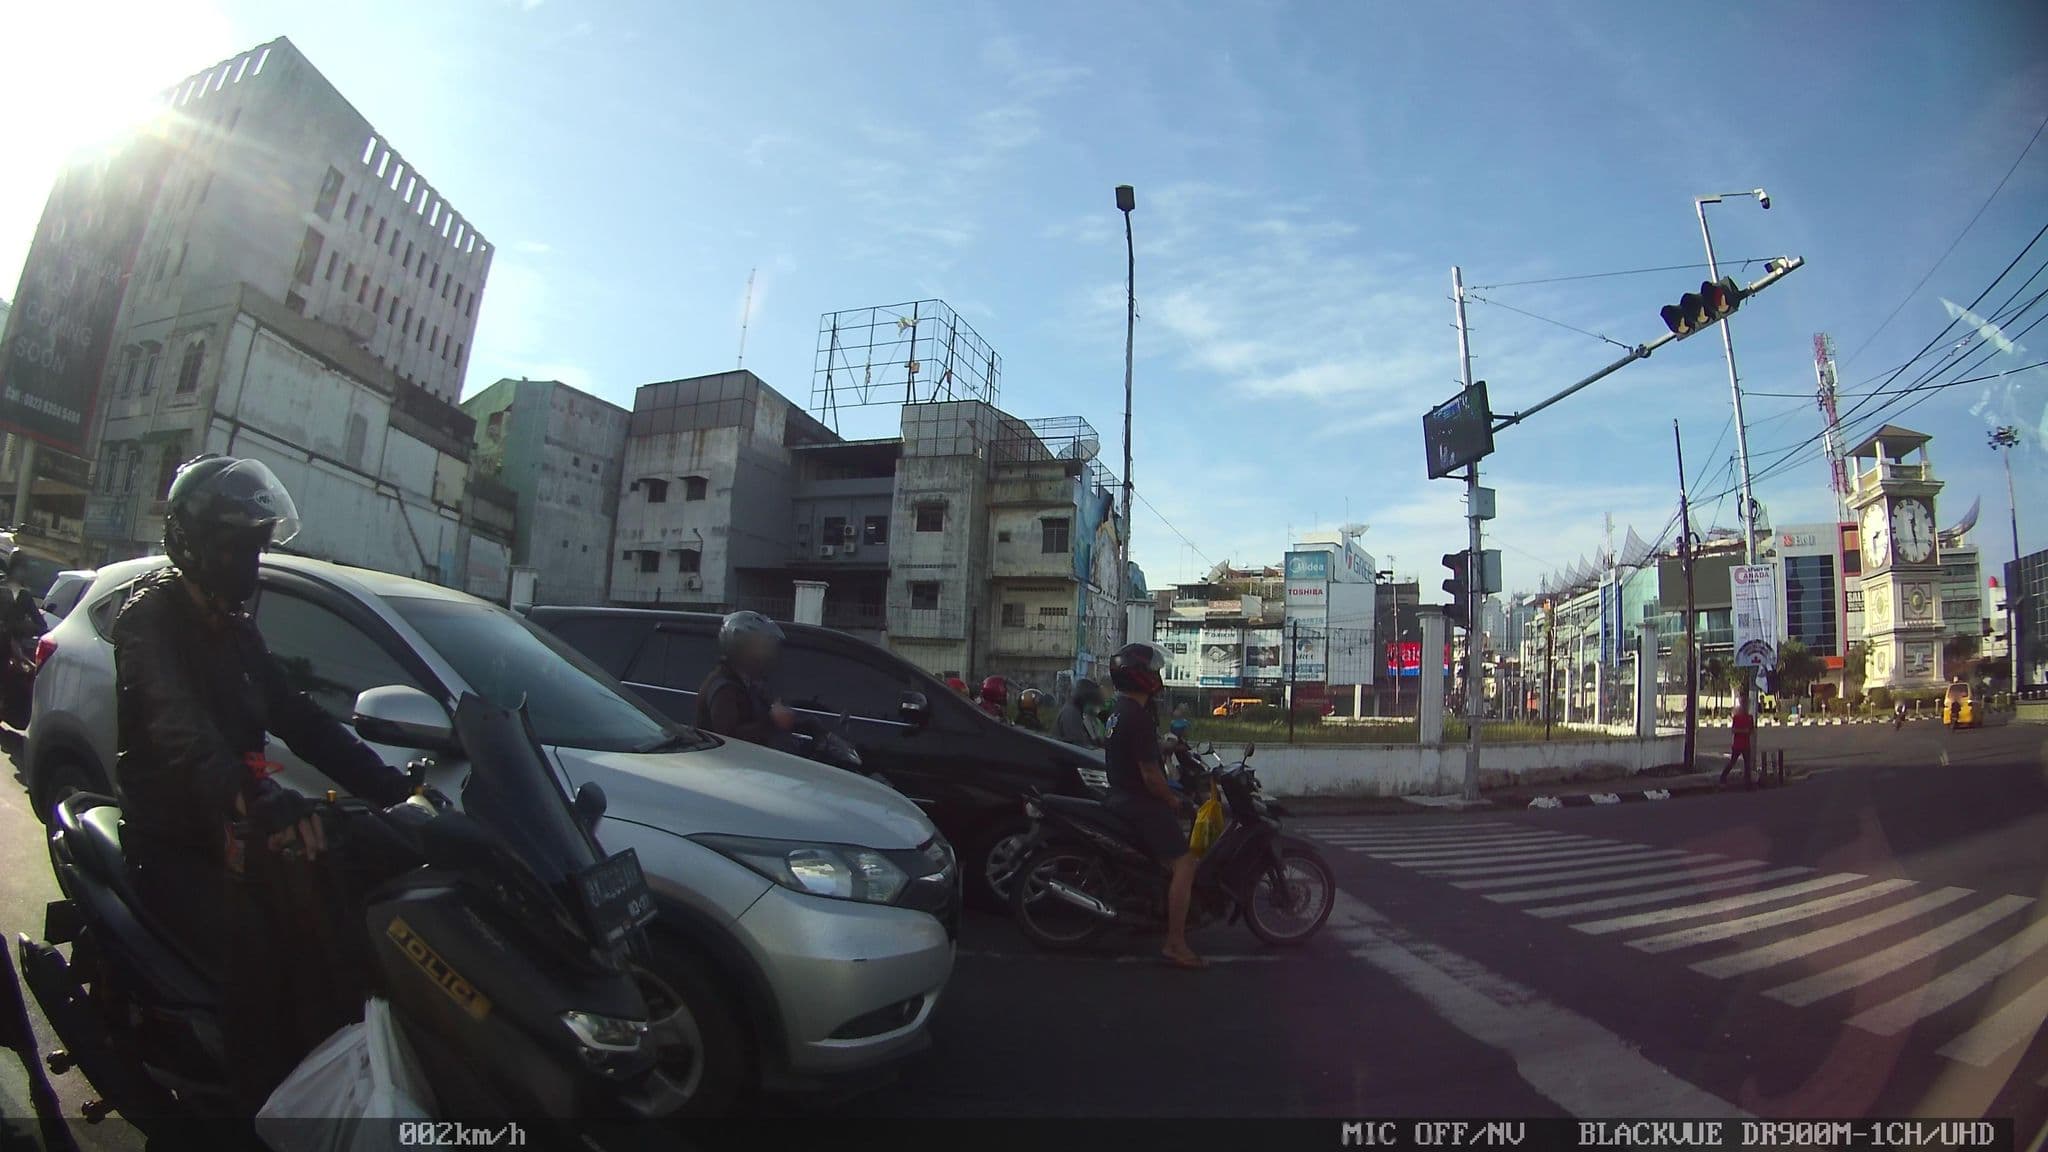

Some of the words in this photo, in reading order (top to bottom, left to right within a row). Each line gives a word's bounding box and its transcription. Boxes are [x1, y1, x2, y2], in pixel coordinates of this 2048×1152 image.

[25, 301, 94, 346] COMING
[15, 335, 67, 375] SOON
[1291, 558, 1324, 573] Midea
[1353, 552, 1373, 581] GREE
[1288, 588, 1323, 597] TOSHIBA
